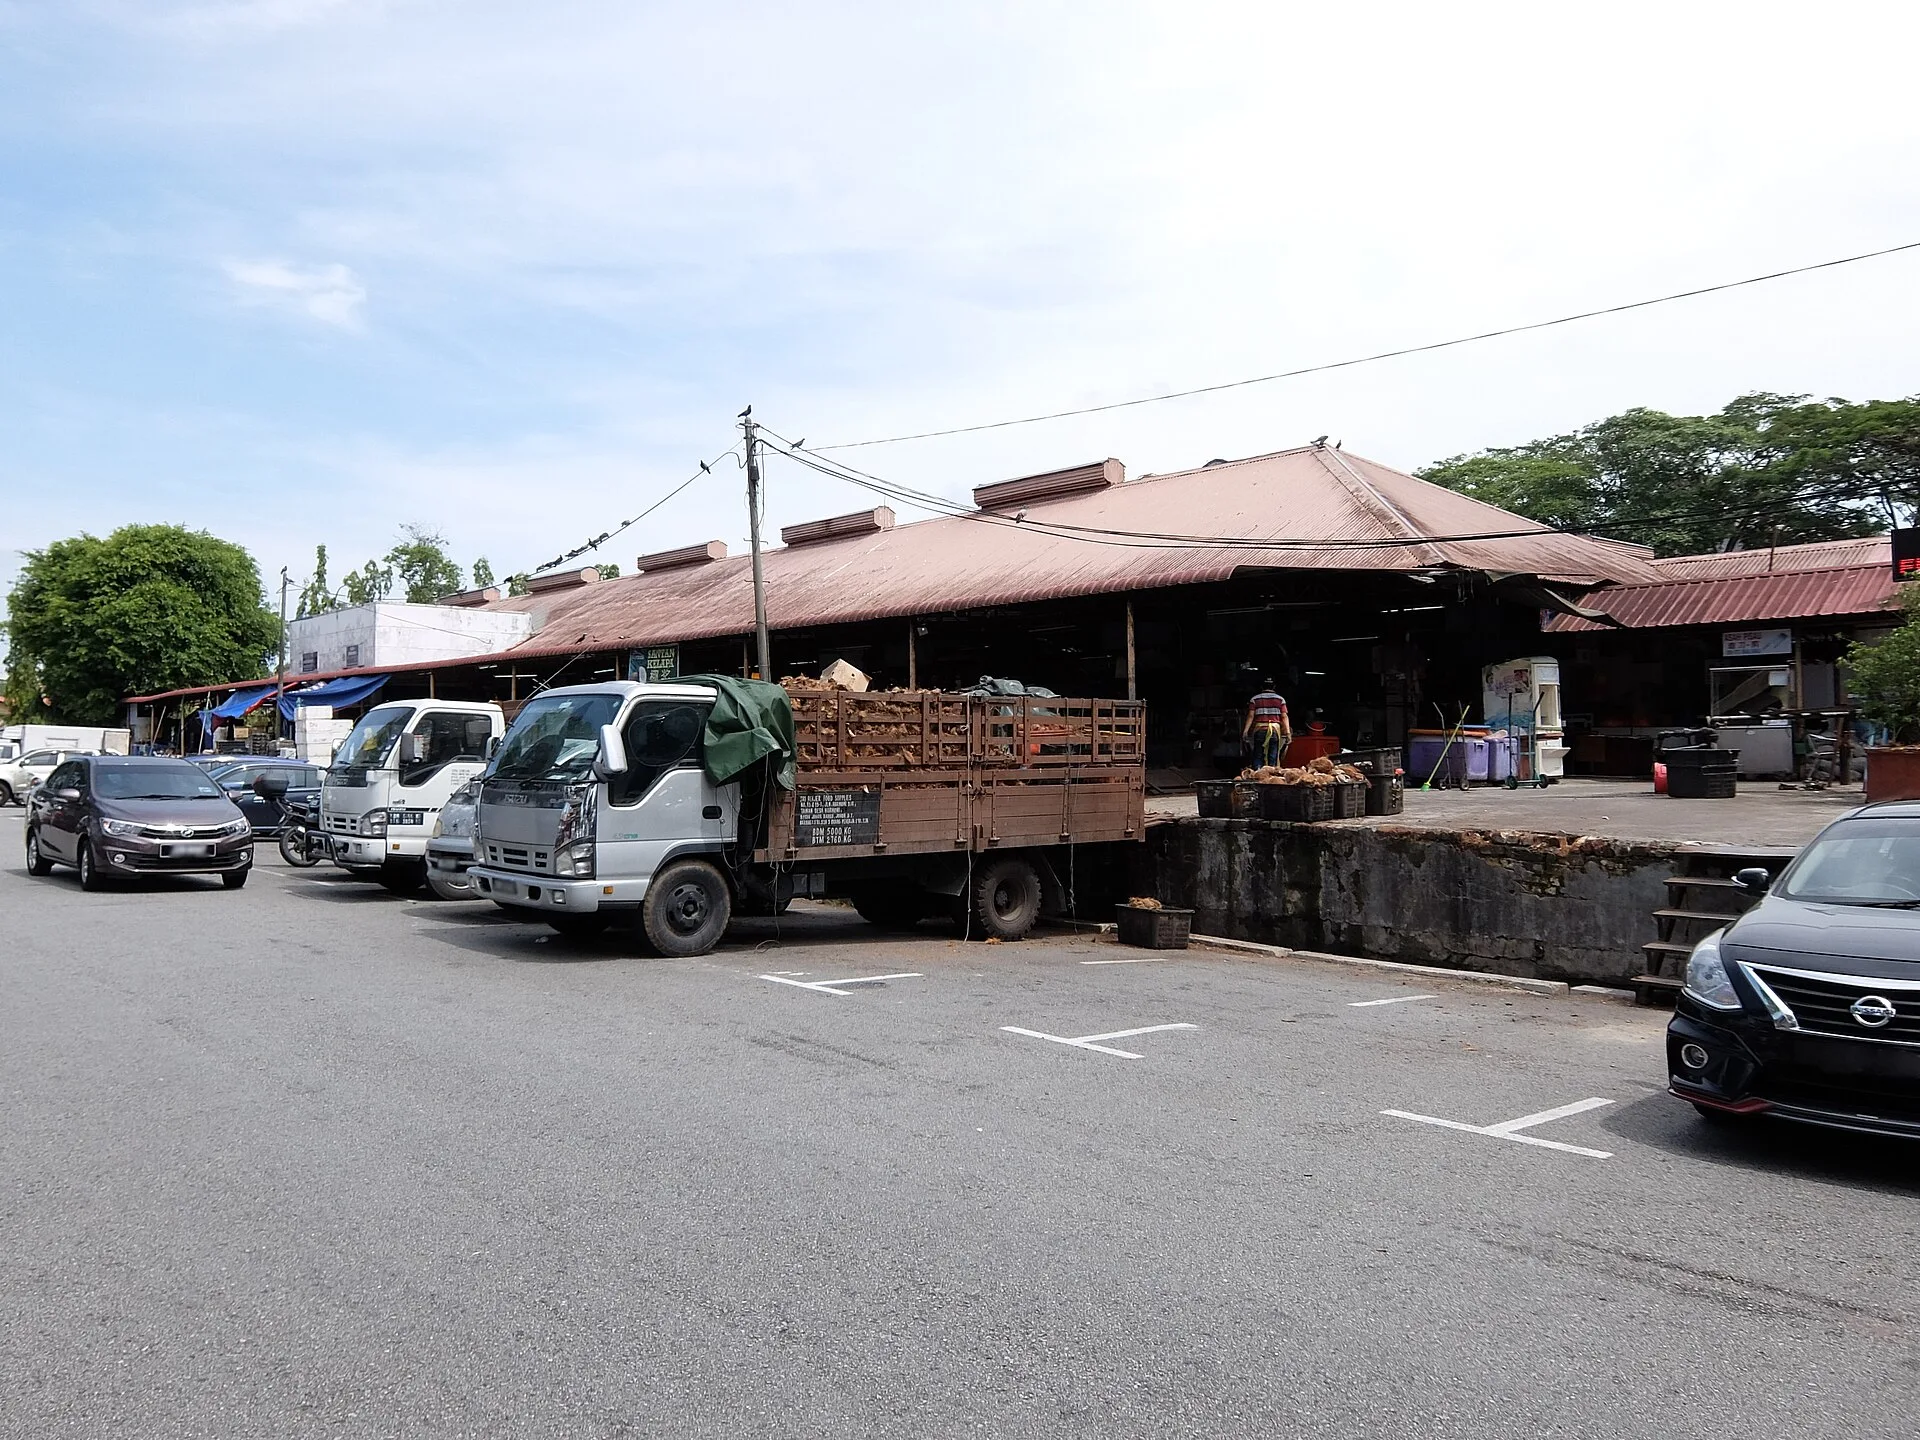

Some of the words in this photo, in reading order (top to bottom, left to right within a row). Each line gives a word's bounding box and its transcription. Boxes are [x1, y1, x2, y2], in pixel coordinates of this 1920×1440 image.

[647, 648, 675, 658] SANTAN
[647, 658, 674, 669] KELAPA
[812, 827, 825, 836] BDM
[826, 827, 843, 836] 5000
[843, 826, 852, 836] KG
[811, 836, 825, 845] BTM
[843, 835, 852, 844] KG
[1851, 1006, 1896, 1016] NISSAN
